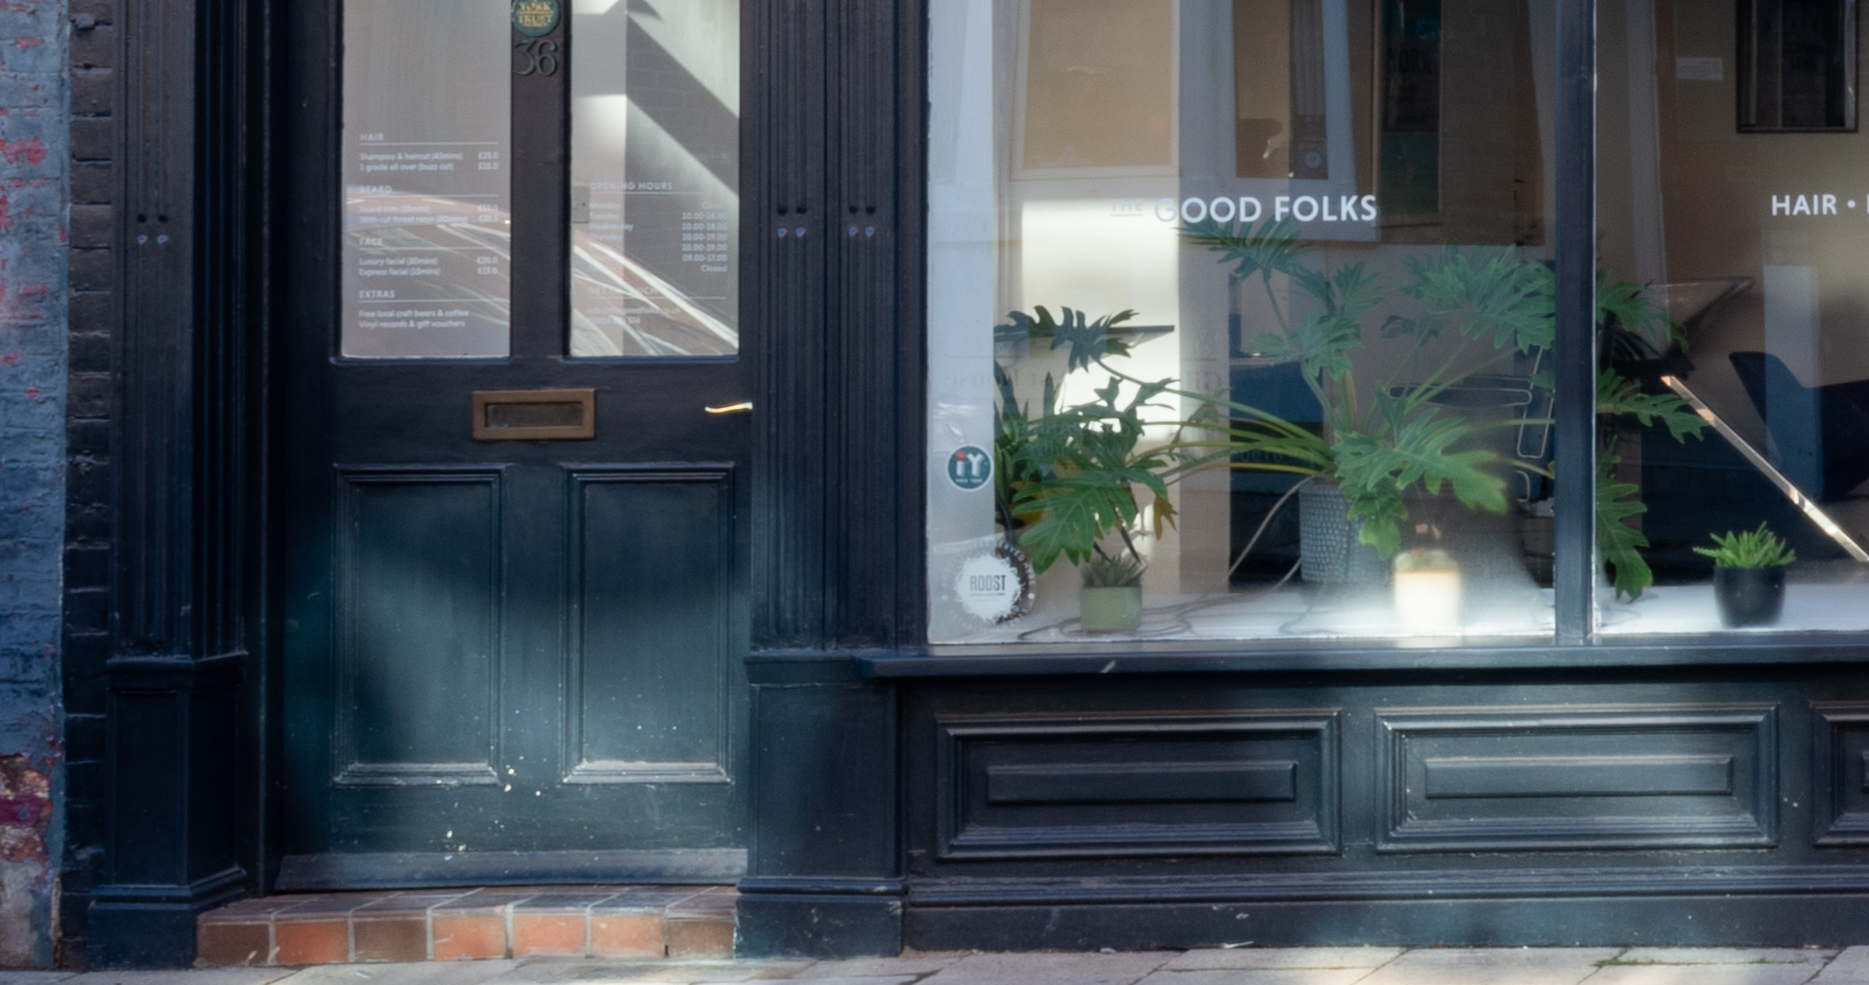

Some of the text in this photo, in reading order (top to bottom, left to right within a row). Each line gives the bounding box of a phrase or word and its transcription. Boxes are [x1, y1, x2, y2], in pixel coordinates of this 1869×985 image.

[514, 39, 558, 76] 36
[359, 133, 384, 141] HAIR
[638, 181, 673, 190] HOURS
[1155, 196, 1263, 224] GOOD
[1274, 194, 1378, 222] FOLKS
[1771, 192, 1838, 217] HAIR
[359, 290, 396, 299] EXTRAS
[969, 574, 1007, 592] ROOST
